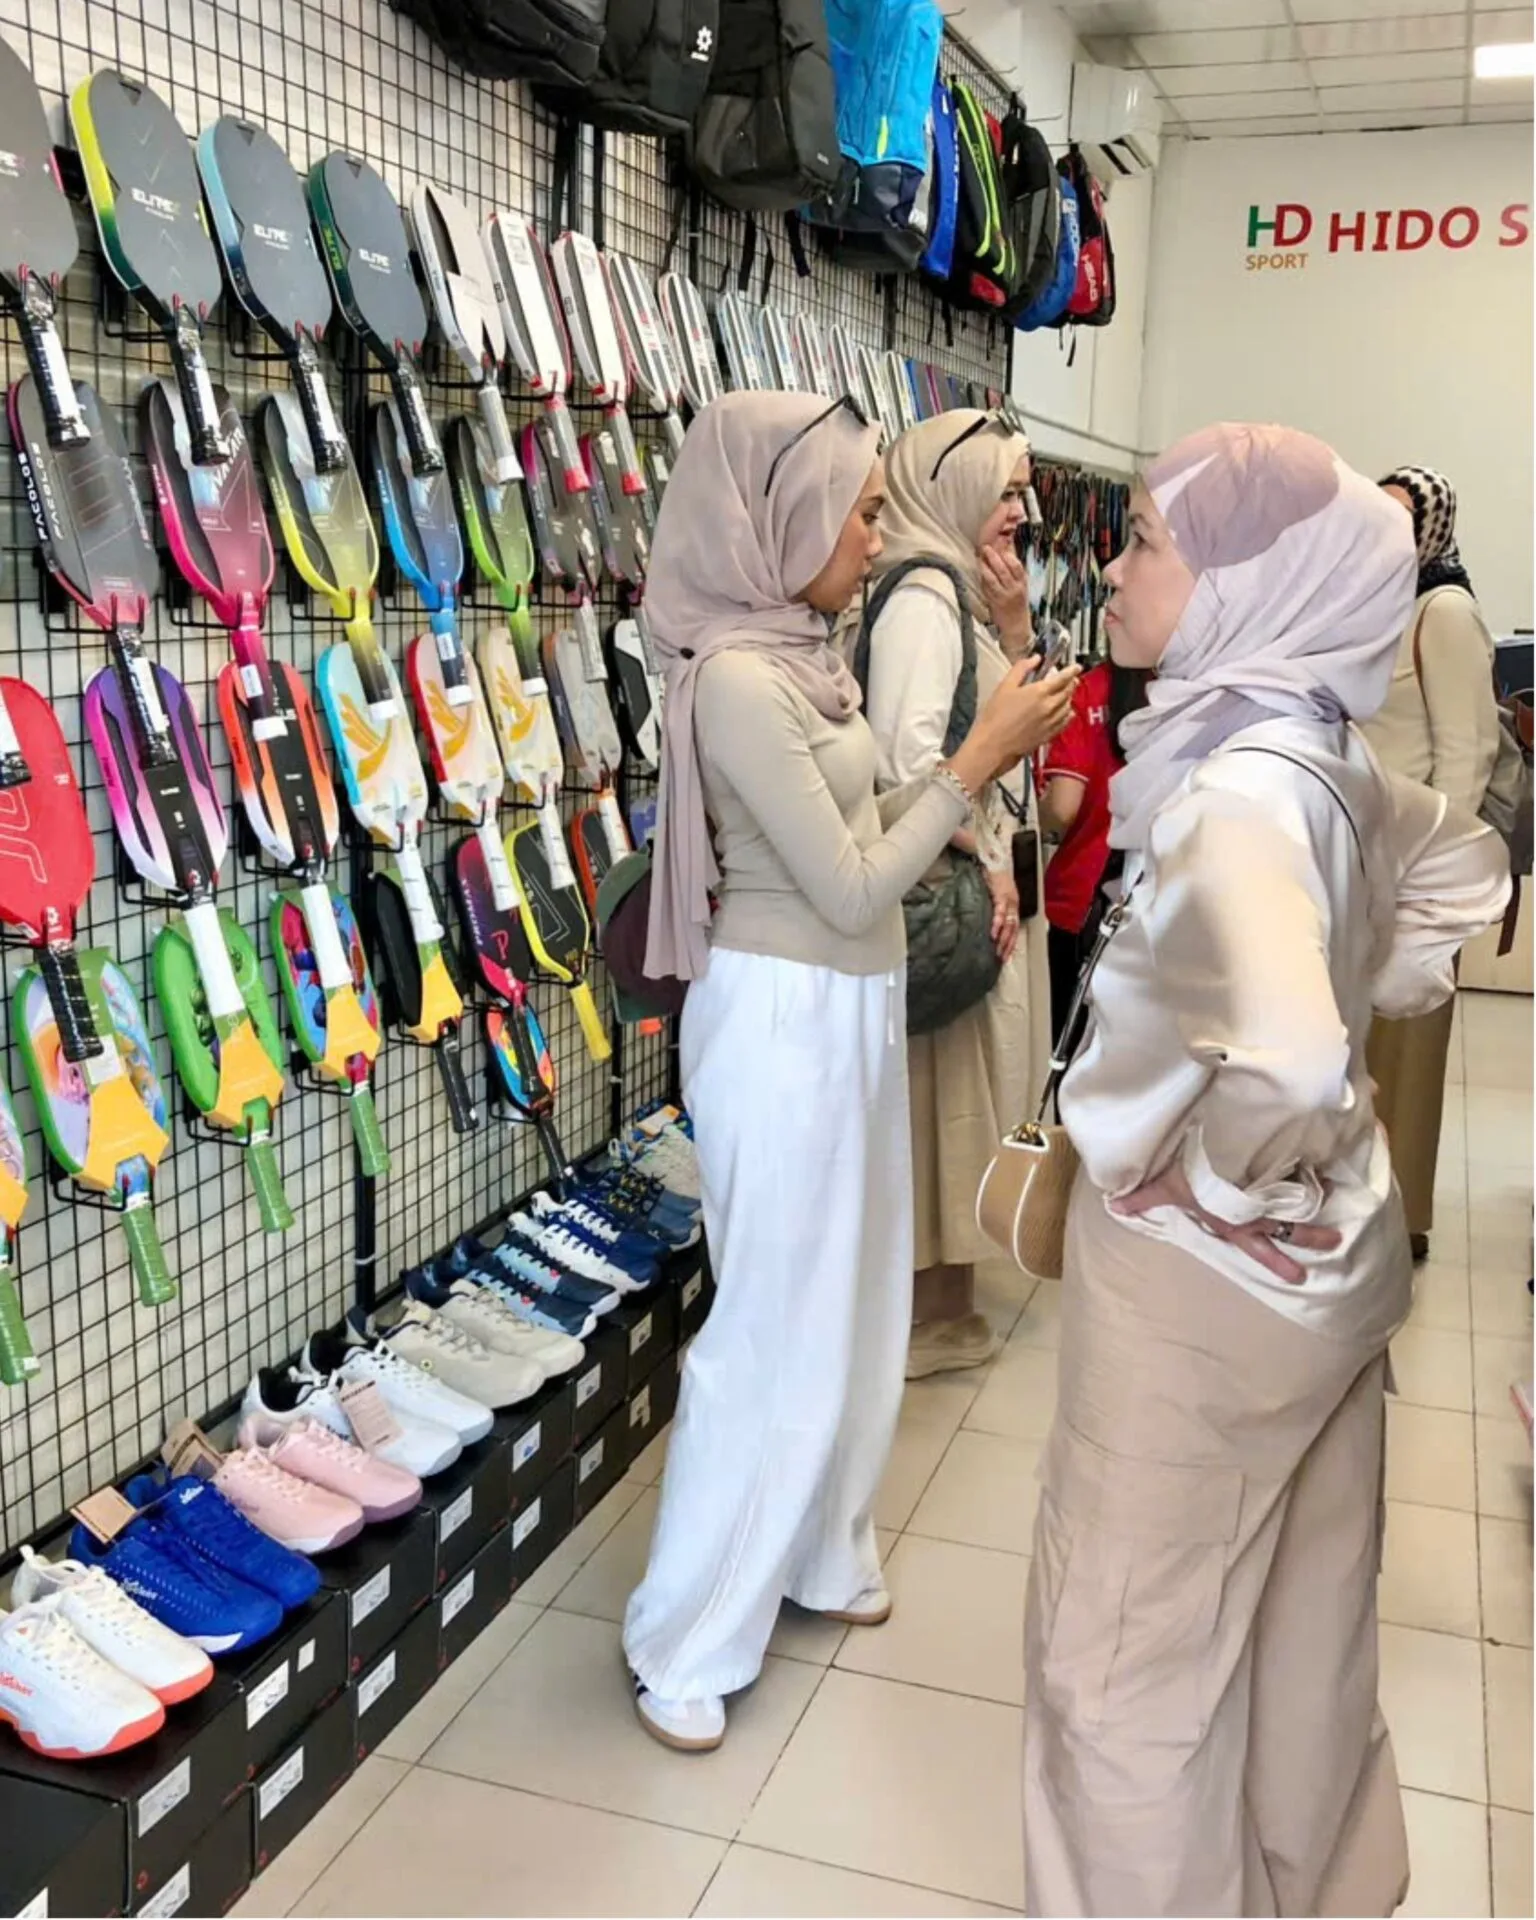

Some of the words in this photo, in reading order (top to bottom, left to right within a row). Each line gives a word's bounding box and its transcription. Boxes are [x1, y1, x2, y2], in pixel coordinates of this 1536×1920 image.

[1247, 203, 1313, 248] HD
[1328, 205, 1480, 252] HIDO
[1245, 252, 1308, 270] SPORT
[18, 452, 48, 540] FACOLOS
